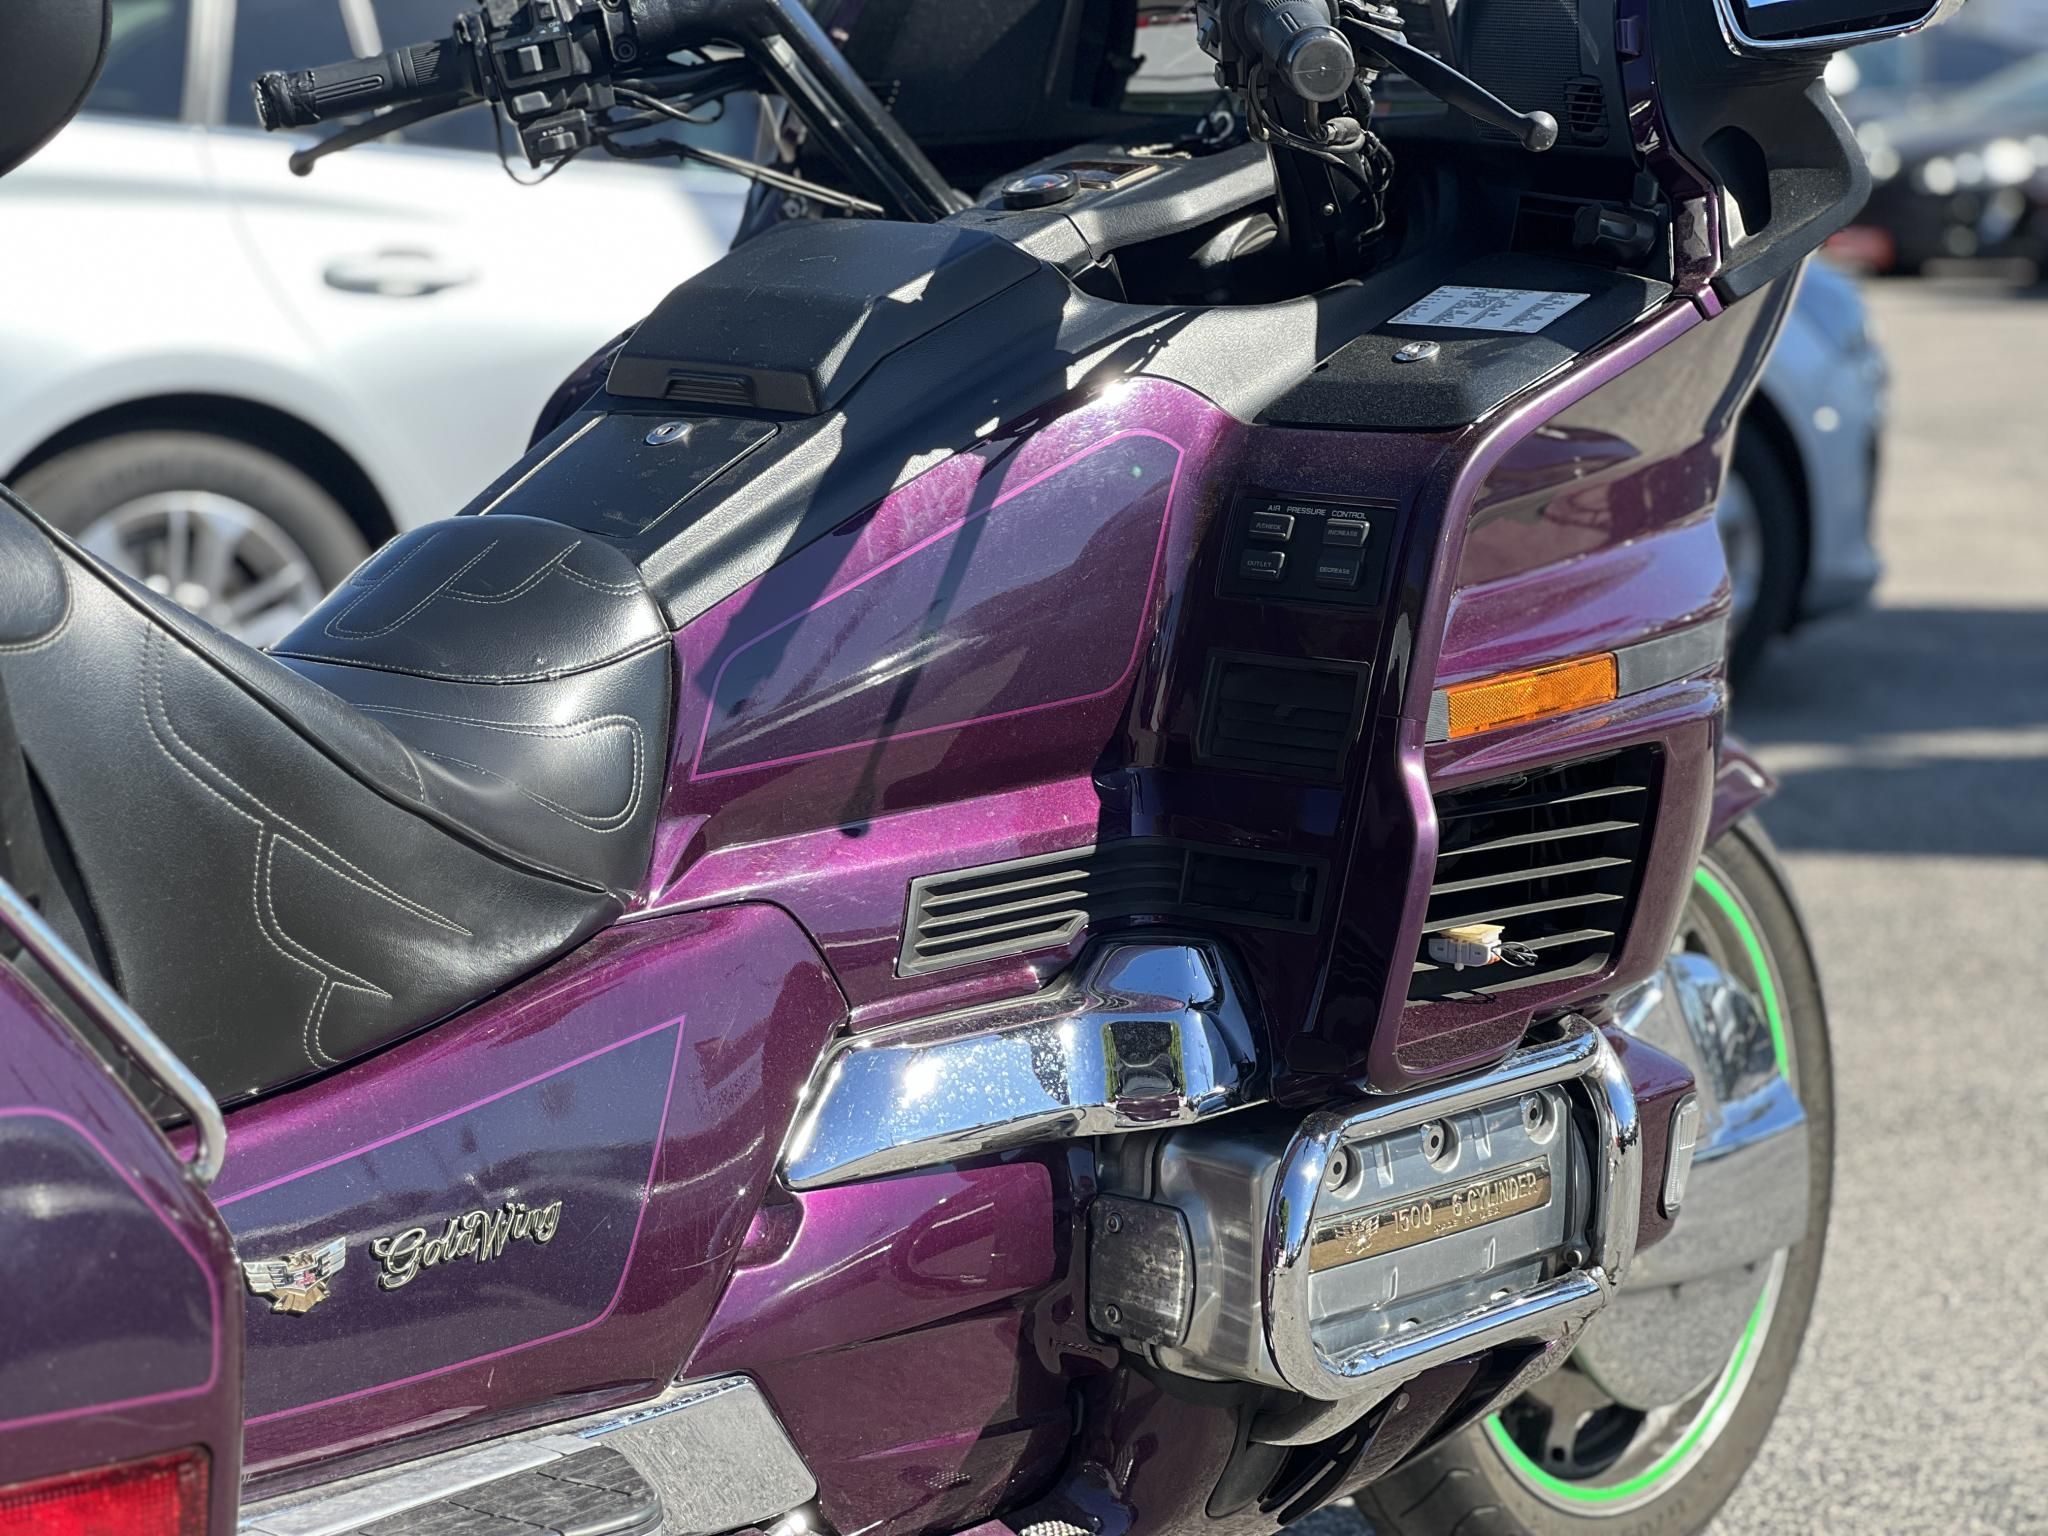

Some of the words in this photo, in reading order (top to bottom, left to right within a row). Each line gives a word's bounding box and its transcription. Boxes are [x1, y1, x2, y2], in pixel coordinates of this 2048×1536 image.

[1286, 506, 1327, 516] PRESSURE
[1331, 510, 1367, 519] CONTROL
[1319, 566, 1350, 575] DECREASE
[1391, 1202, 1433, 1234] 1500
[1452, 1193, 1463, 1217] 6
[1468, 1172, 1537, 1212] CYLINDER
